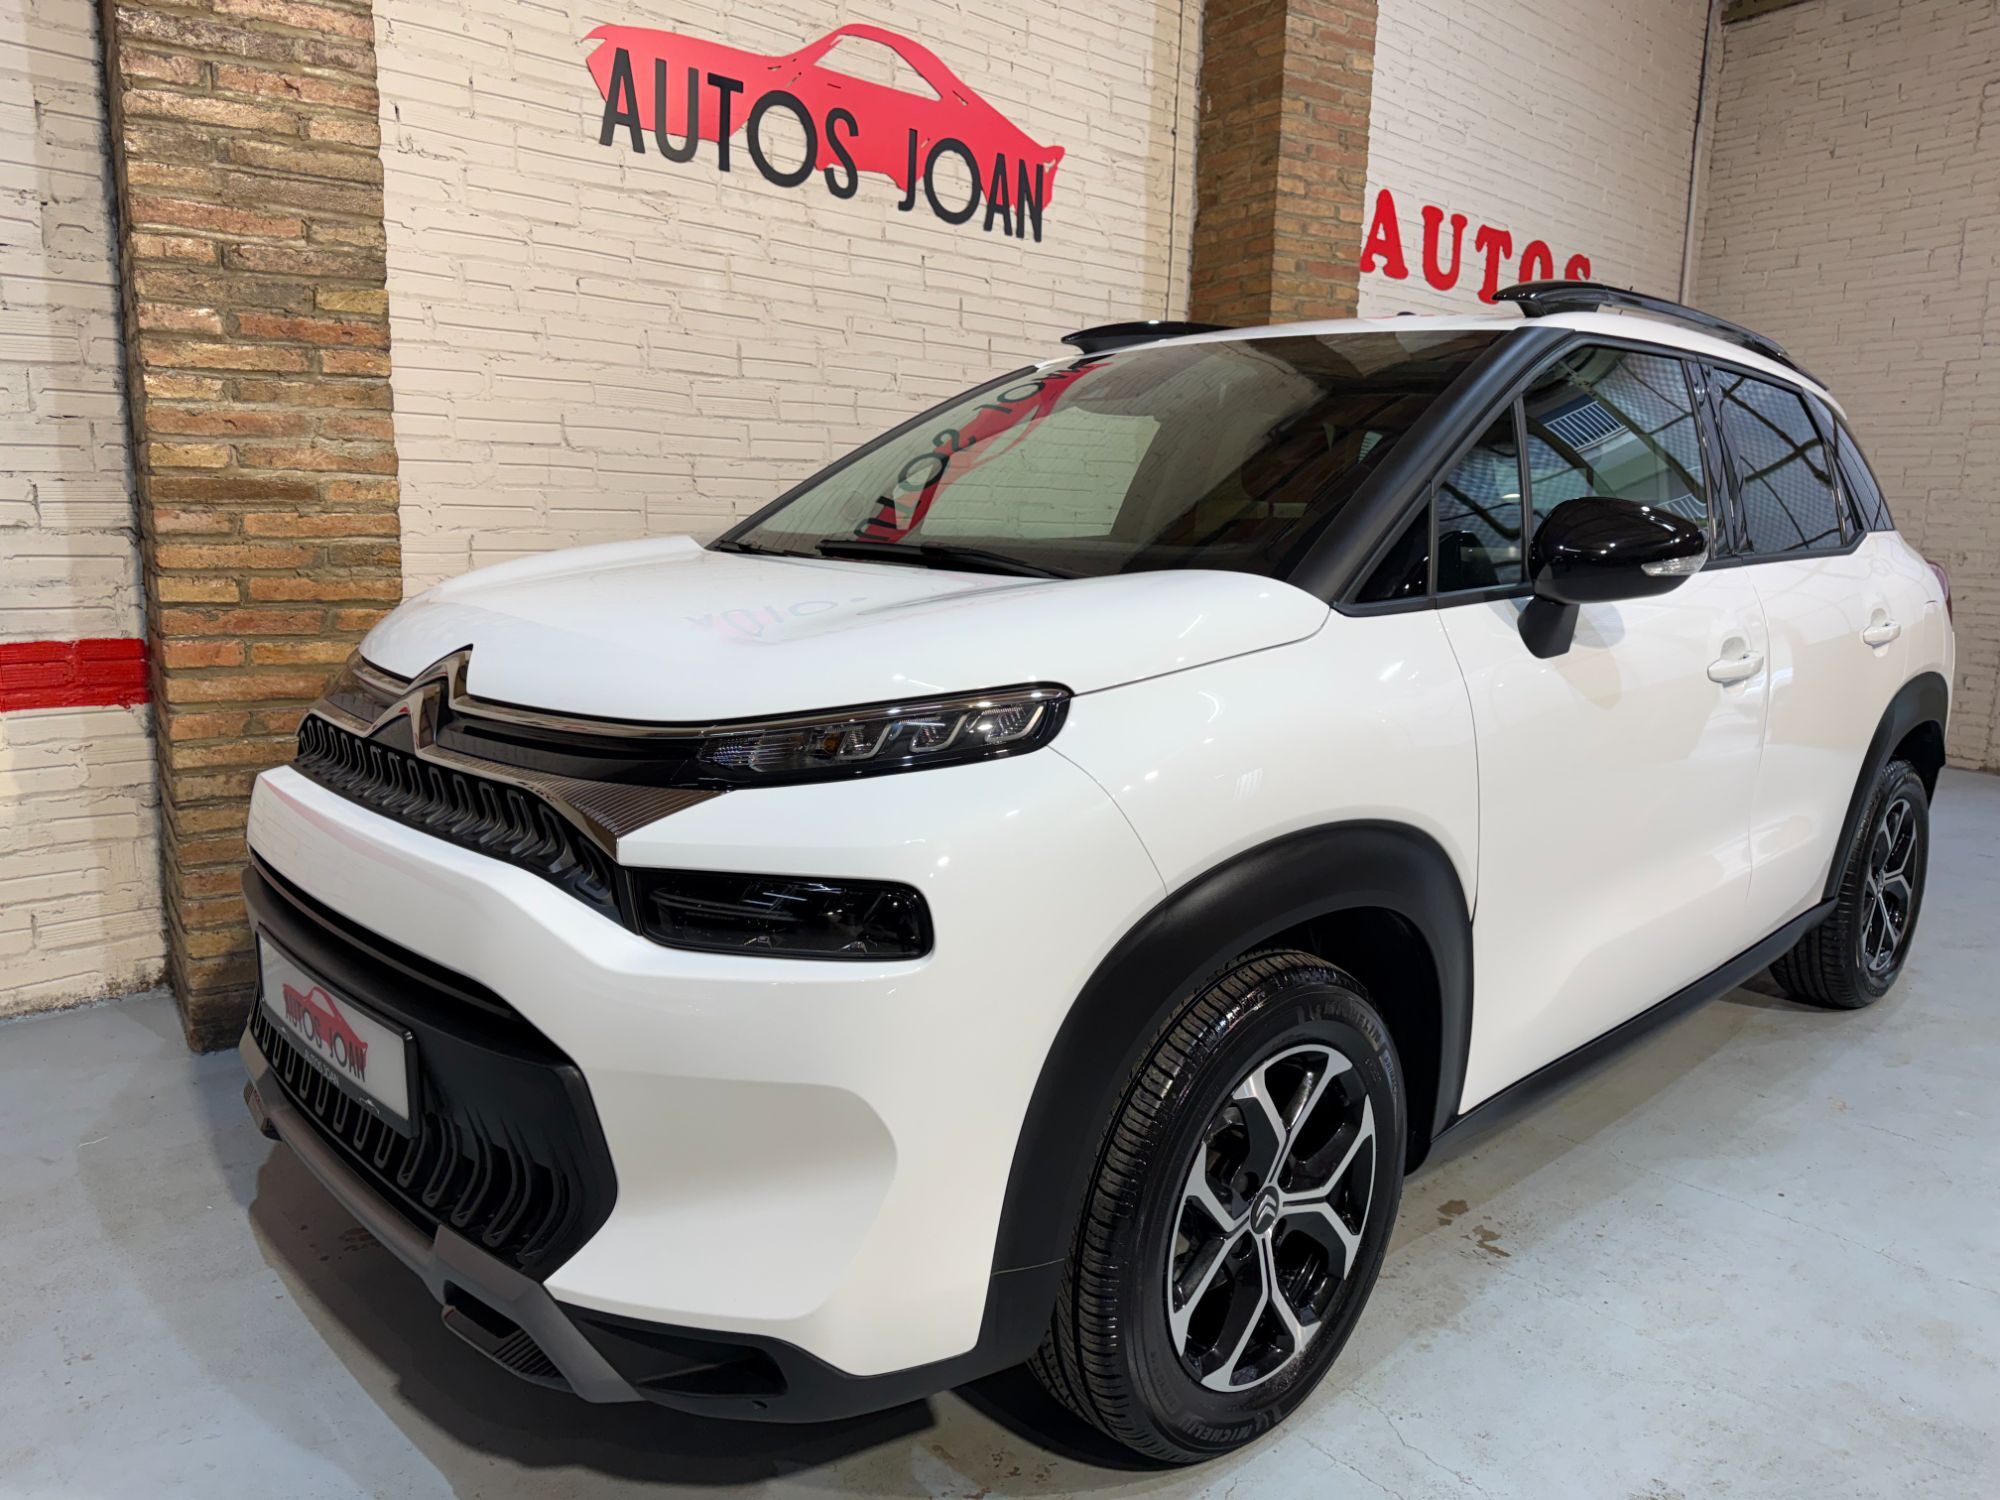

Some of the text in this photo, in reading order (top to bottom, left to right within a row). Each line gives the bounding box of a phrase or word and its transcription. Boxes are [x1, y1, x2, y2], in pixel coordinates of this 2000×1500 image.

[599, 47, 1044, 243] AUTOS JOAN
[283, 989, 366, 1083] AUTOS JOAN
[1180, 1419, 1252, 1442] MICHELIN
